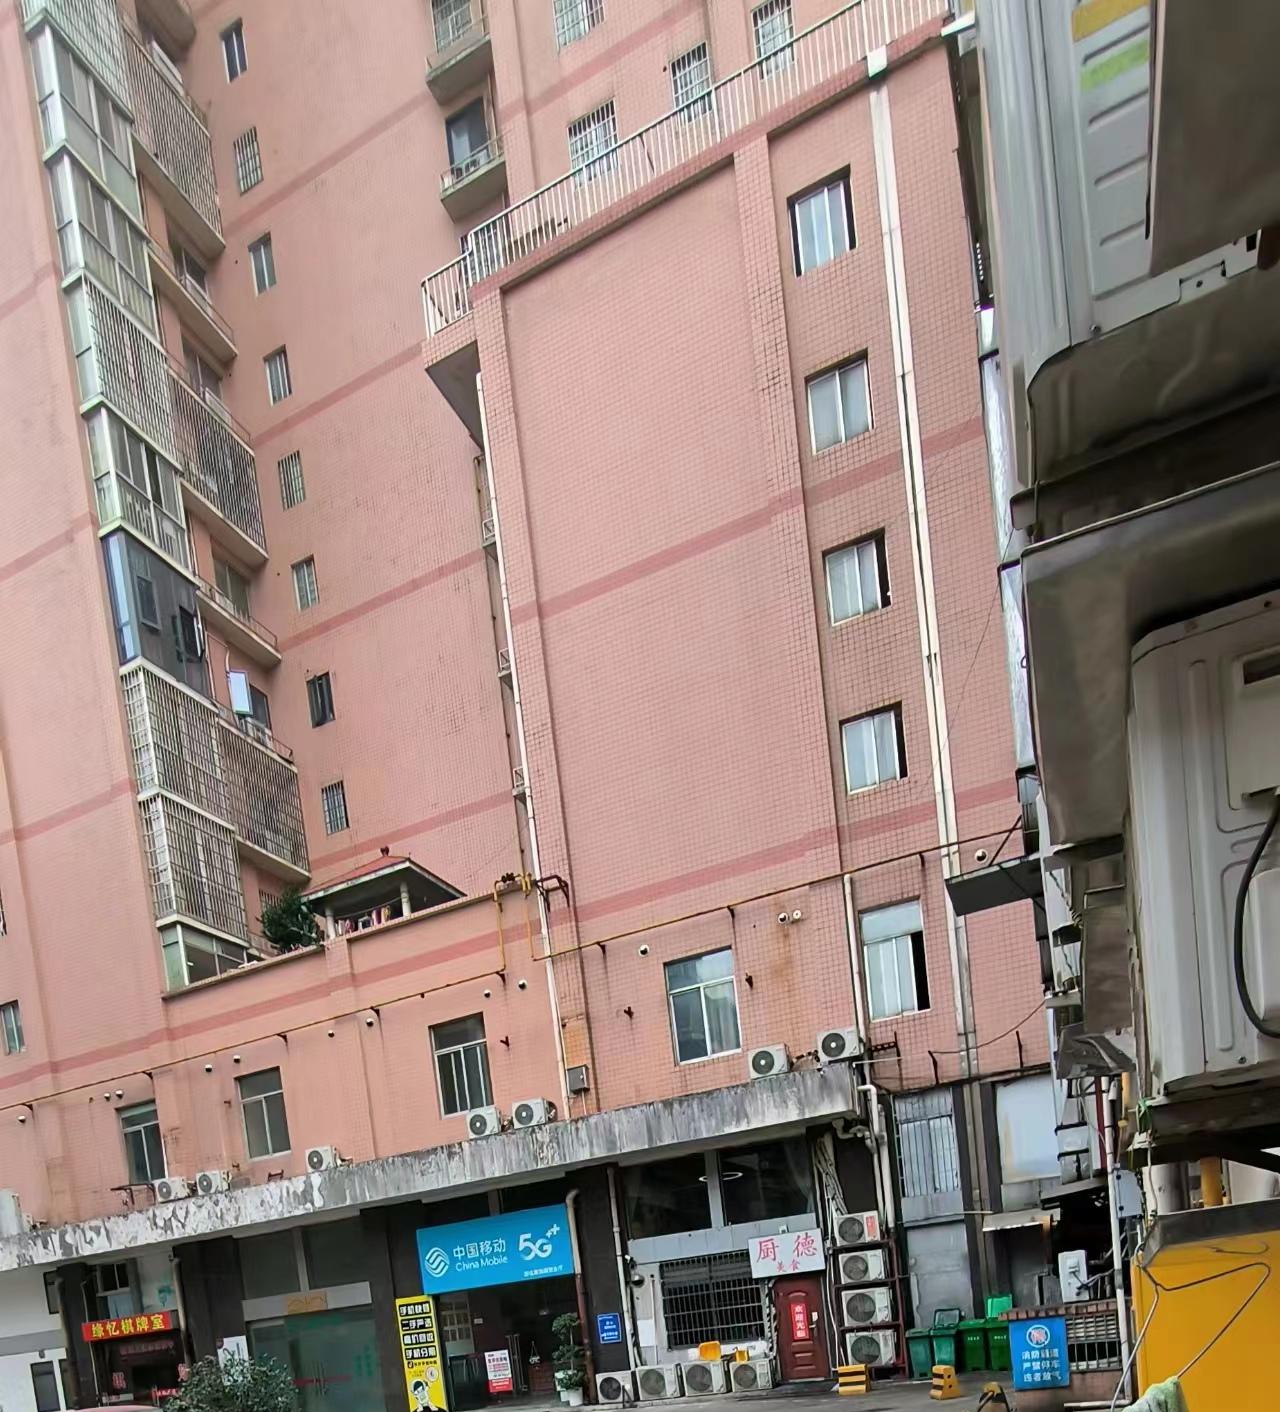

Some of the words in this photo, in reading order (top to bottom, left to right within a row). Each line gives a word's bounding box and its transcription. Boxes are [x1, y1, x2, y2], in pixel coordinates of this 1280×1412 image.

[453, 1238, 506, 1260] 中国移动
[757, 1232, 818, 1262] 厨德
[455, 1260, 480, 1272] China
[480, 1255, 508, 1267] Mobile
[1023, 1360, 1060, 1371] 严禁停车
